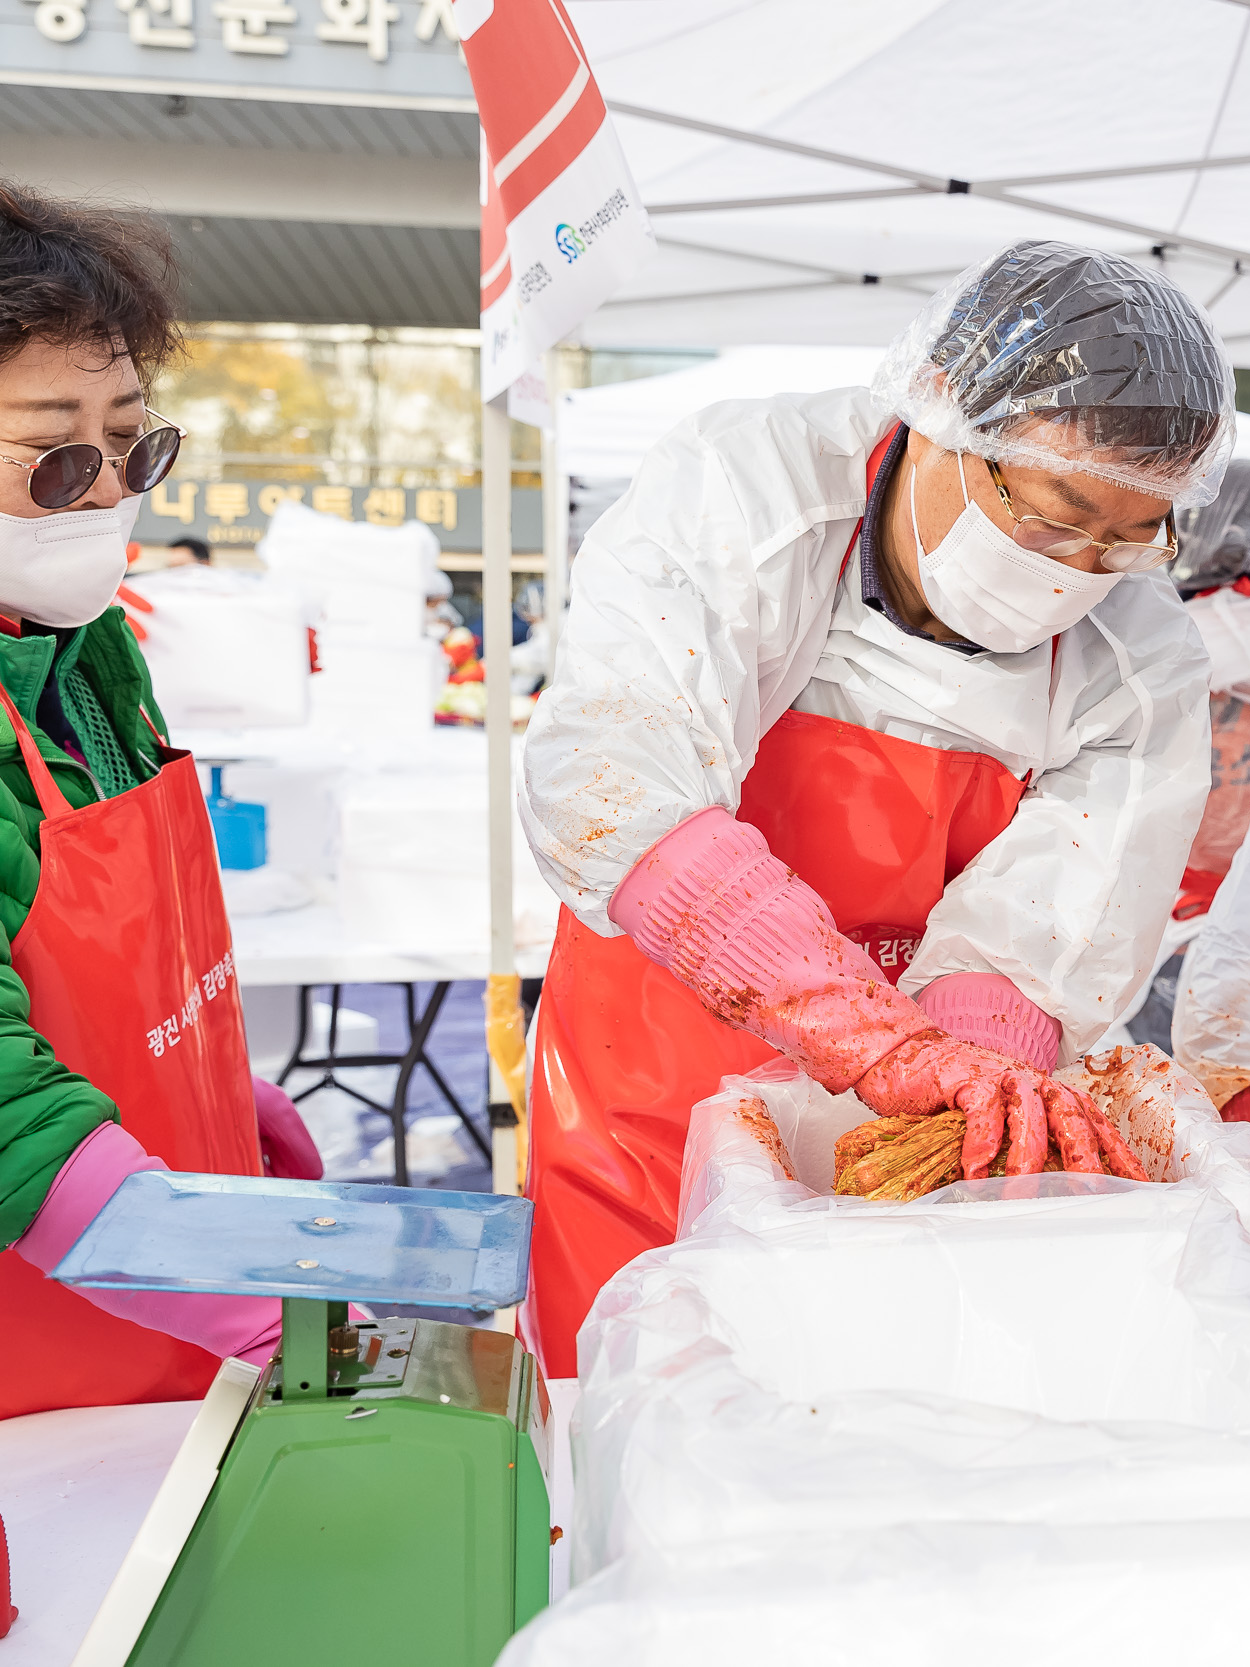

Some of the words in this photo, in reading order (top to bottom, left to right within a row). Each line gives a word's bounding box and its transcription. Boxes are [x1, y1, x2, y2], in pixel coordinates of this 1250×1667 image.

[146, 1014, 181, 1057] 광진
[181, 981, 204, 1029] 사랑의
[201, 948, 234, 1001] 김장축
